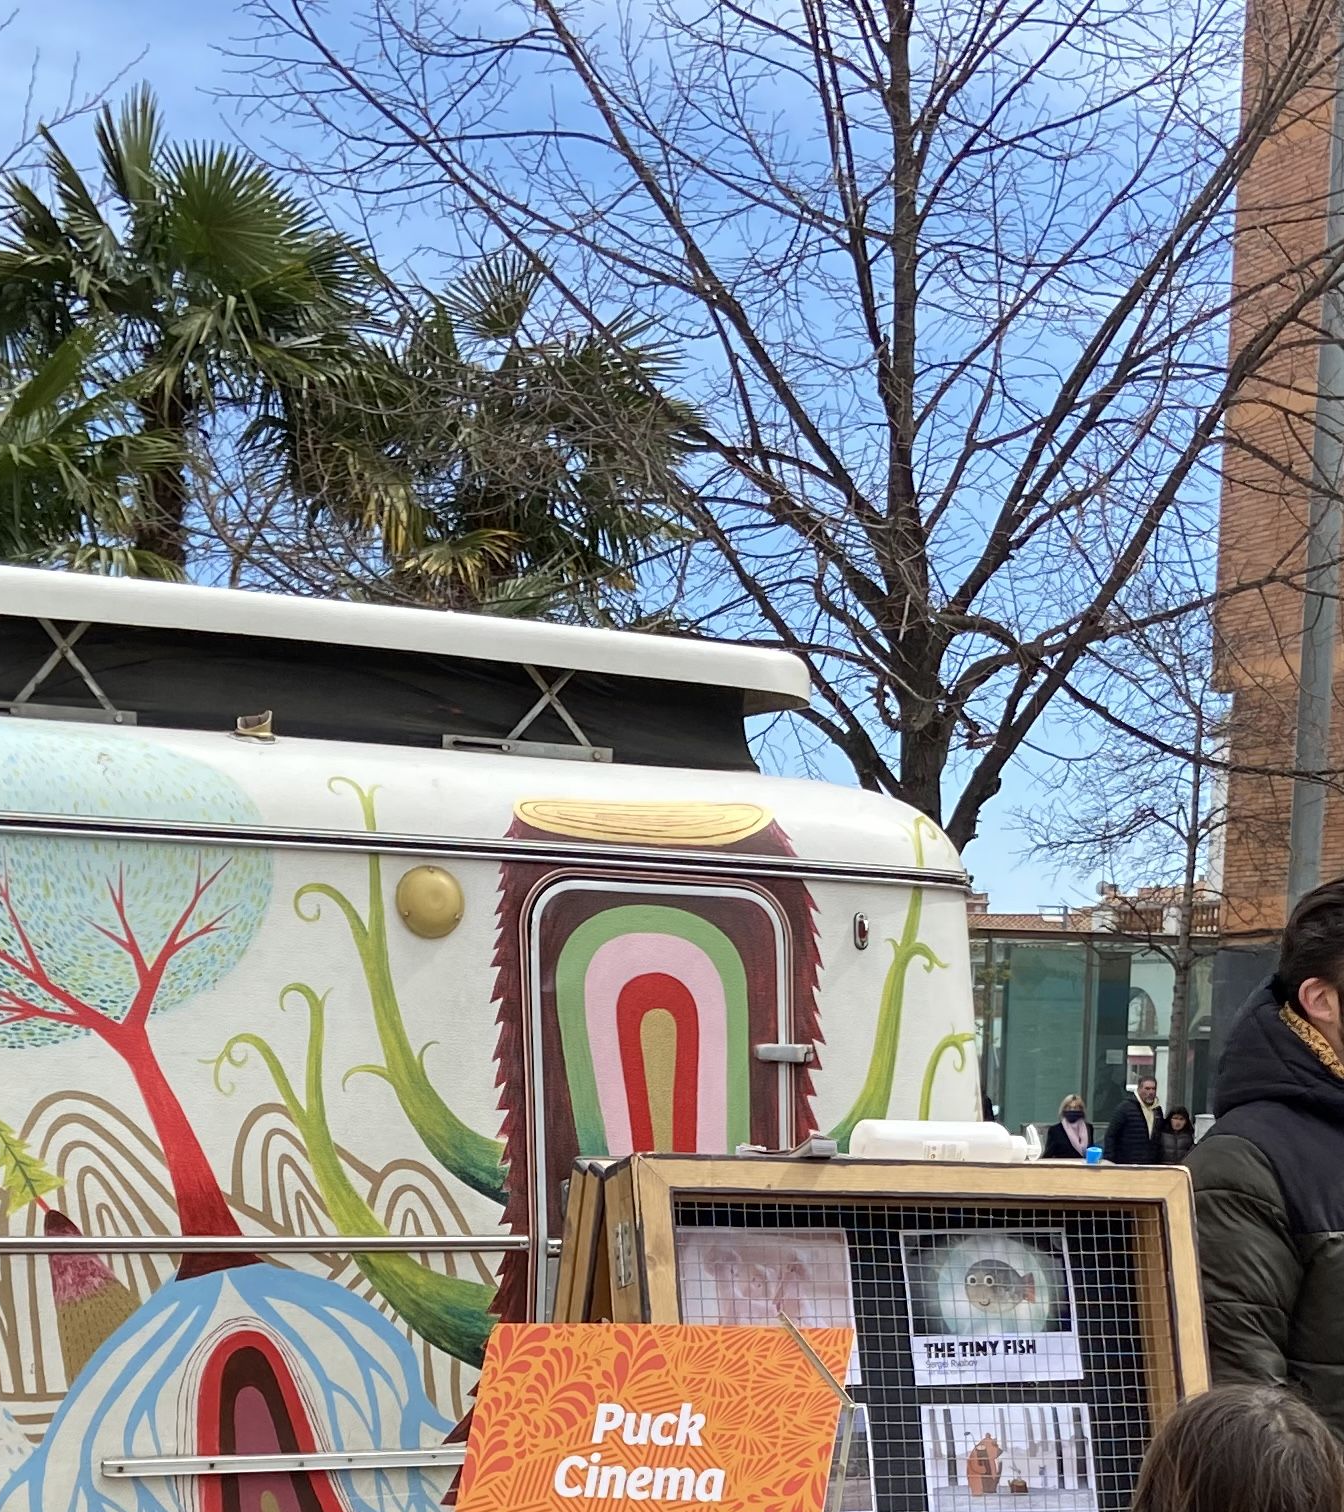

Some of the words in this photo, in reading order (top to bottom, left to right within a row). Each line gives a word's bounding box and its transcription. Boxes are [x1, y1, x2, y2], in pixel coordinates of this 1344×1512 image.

[923, 1342, 956, 1359] THE
[959, 1340, 999, 1357] TINY
[1003, 1339, 1037, 1355] FISH
[591, 1402, 707, 1447] Puck
[553, 1452, 726, 1502] Cinema
